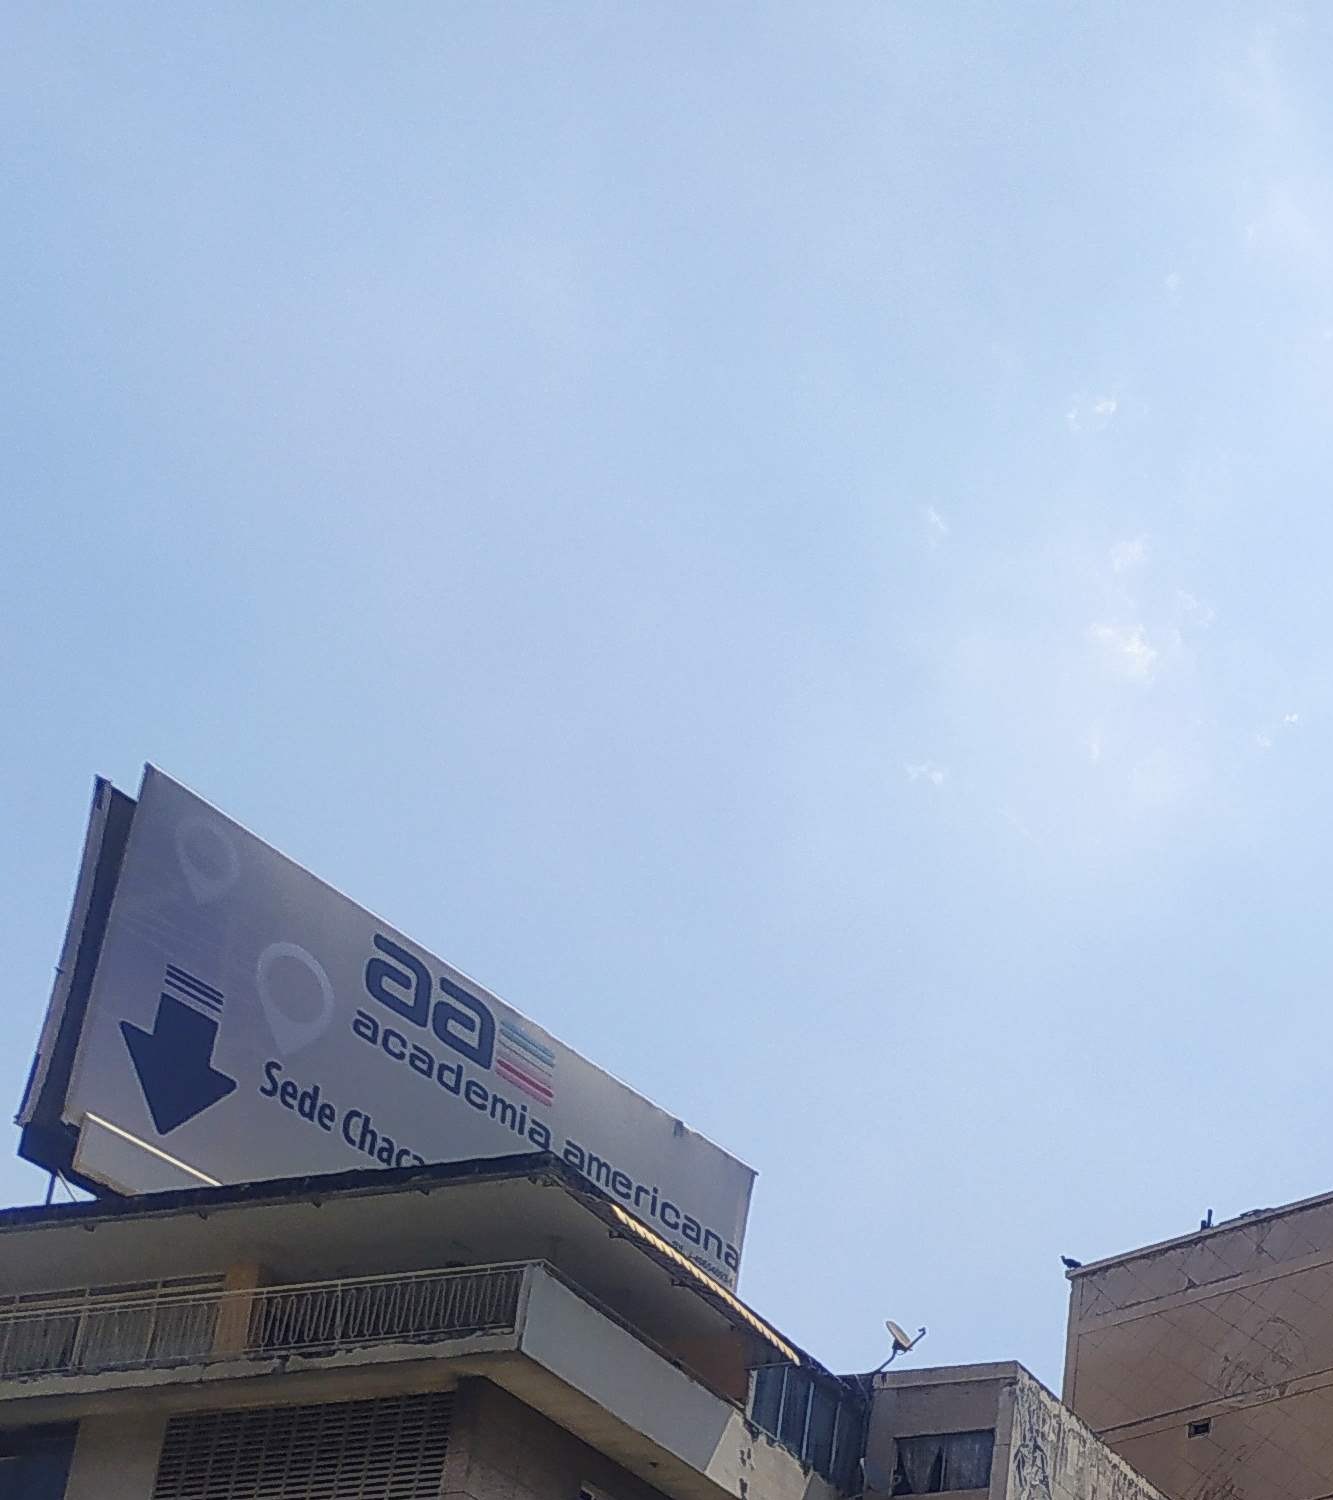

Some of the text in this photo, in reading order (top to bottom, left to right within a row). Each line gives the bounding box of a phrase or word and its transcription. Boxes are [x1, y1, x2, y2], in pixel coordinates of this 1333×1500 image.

[260, 1061, 336, 1132] Sede
[353, 1009, 739, 1273] academia americana
